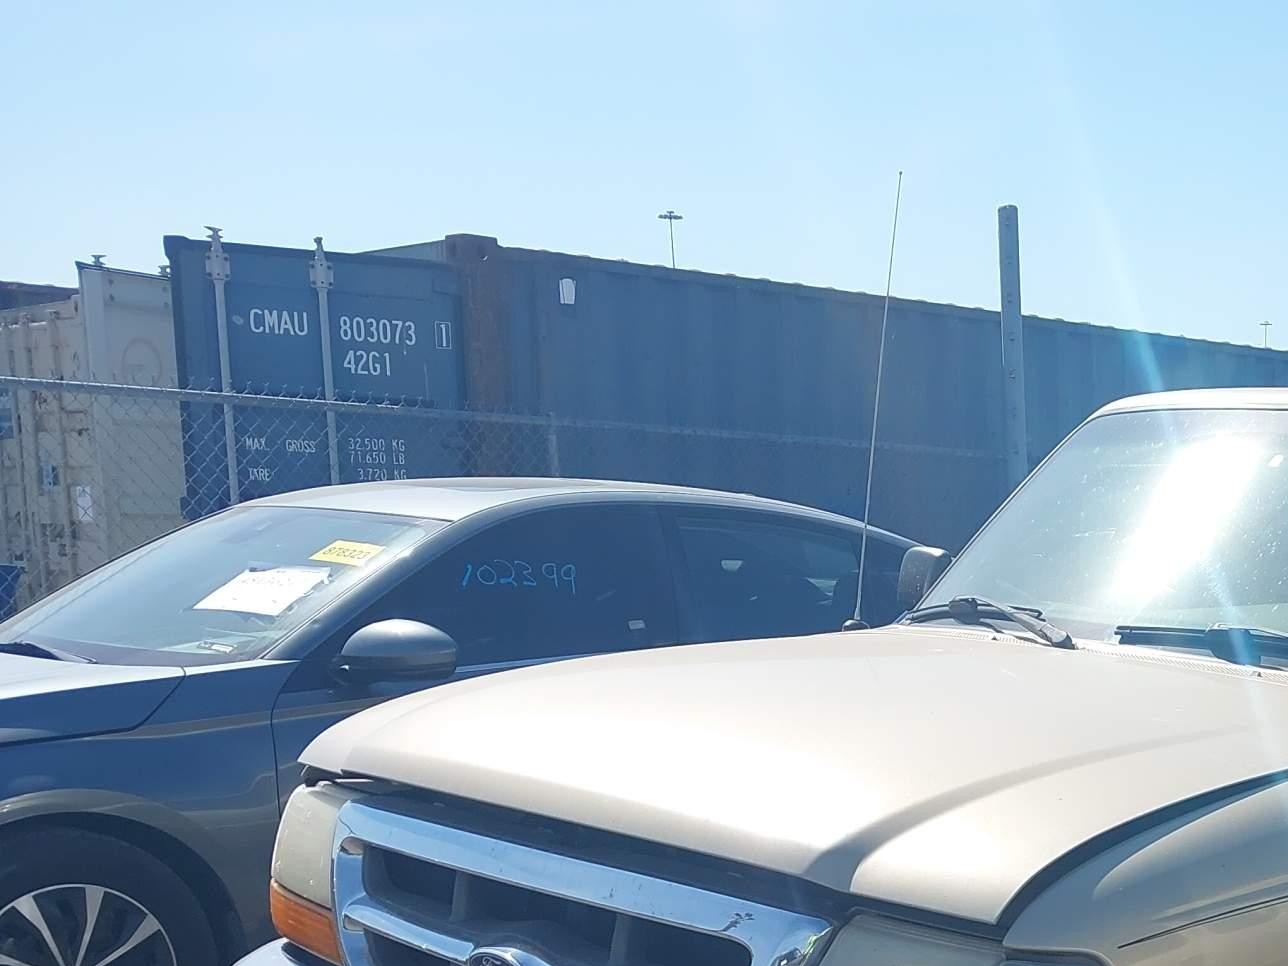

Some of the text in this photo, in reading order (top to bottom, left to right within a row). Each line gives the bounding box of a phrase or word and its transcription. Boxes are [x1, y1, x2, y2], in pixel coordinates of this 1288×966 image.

[250, 308, 449, 348] CMAU 803073 1
[343, 350, 391, 377] 42G1
[285, 439, 316, 453] GROSS
[392, 438, 405, 452] KG
[393, 452, 405, 465] LB
[462, 558, 577, 595] 102399
